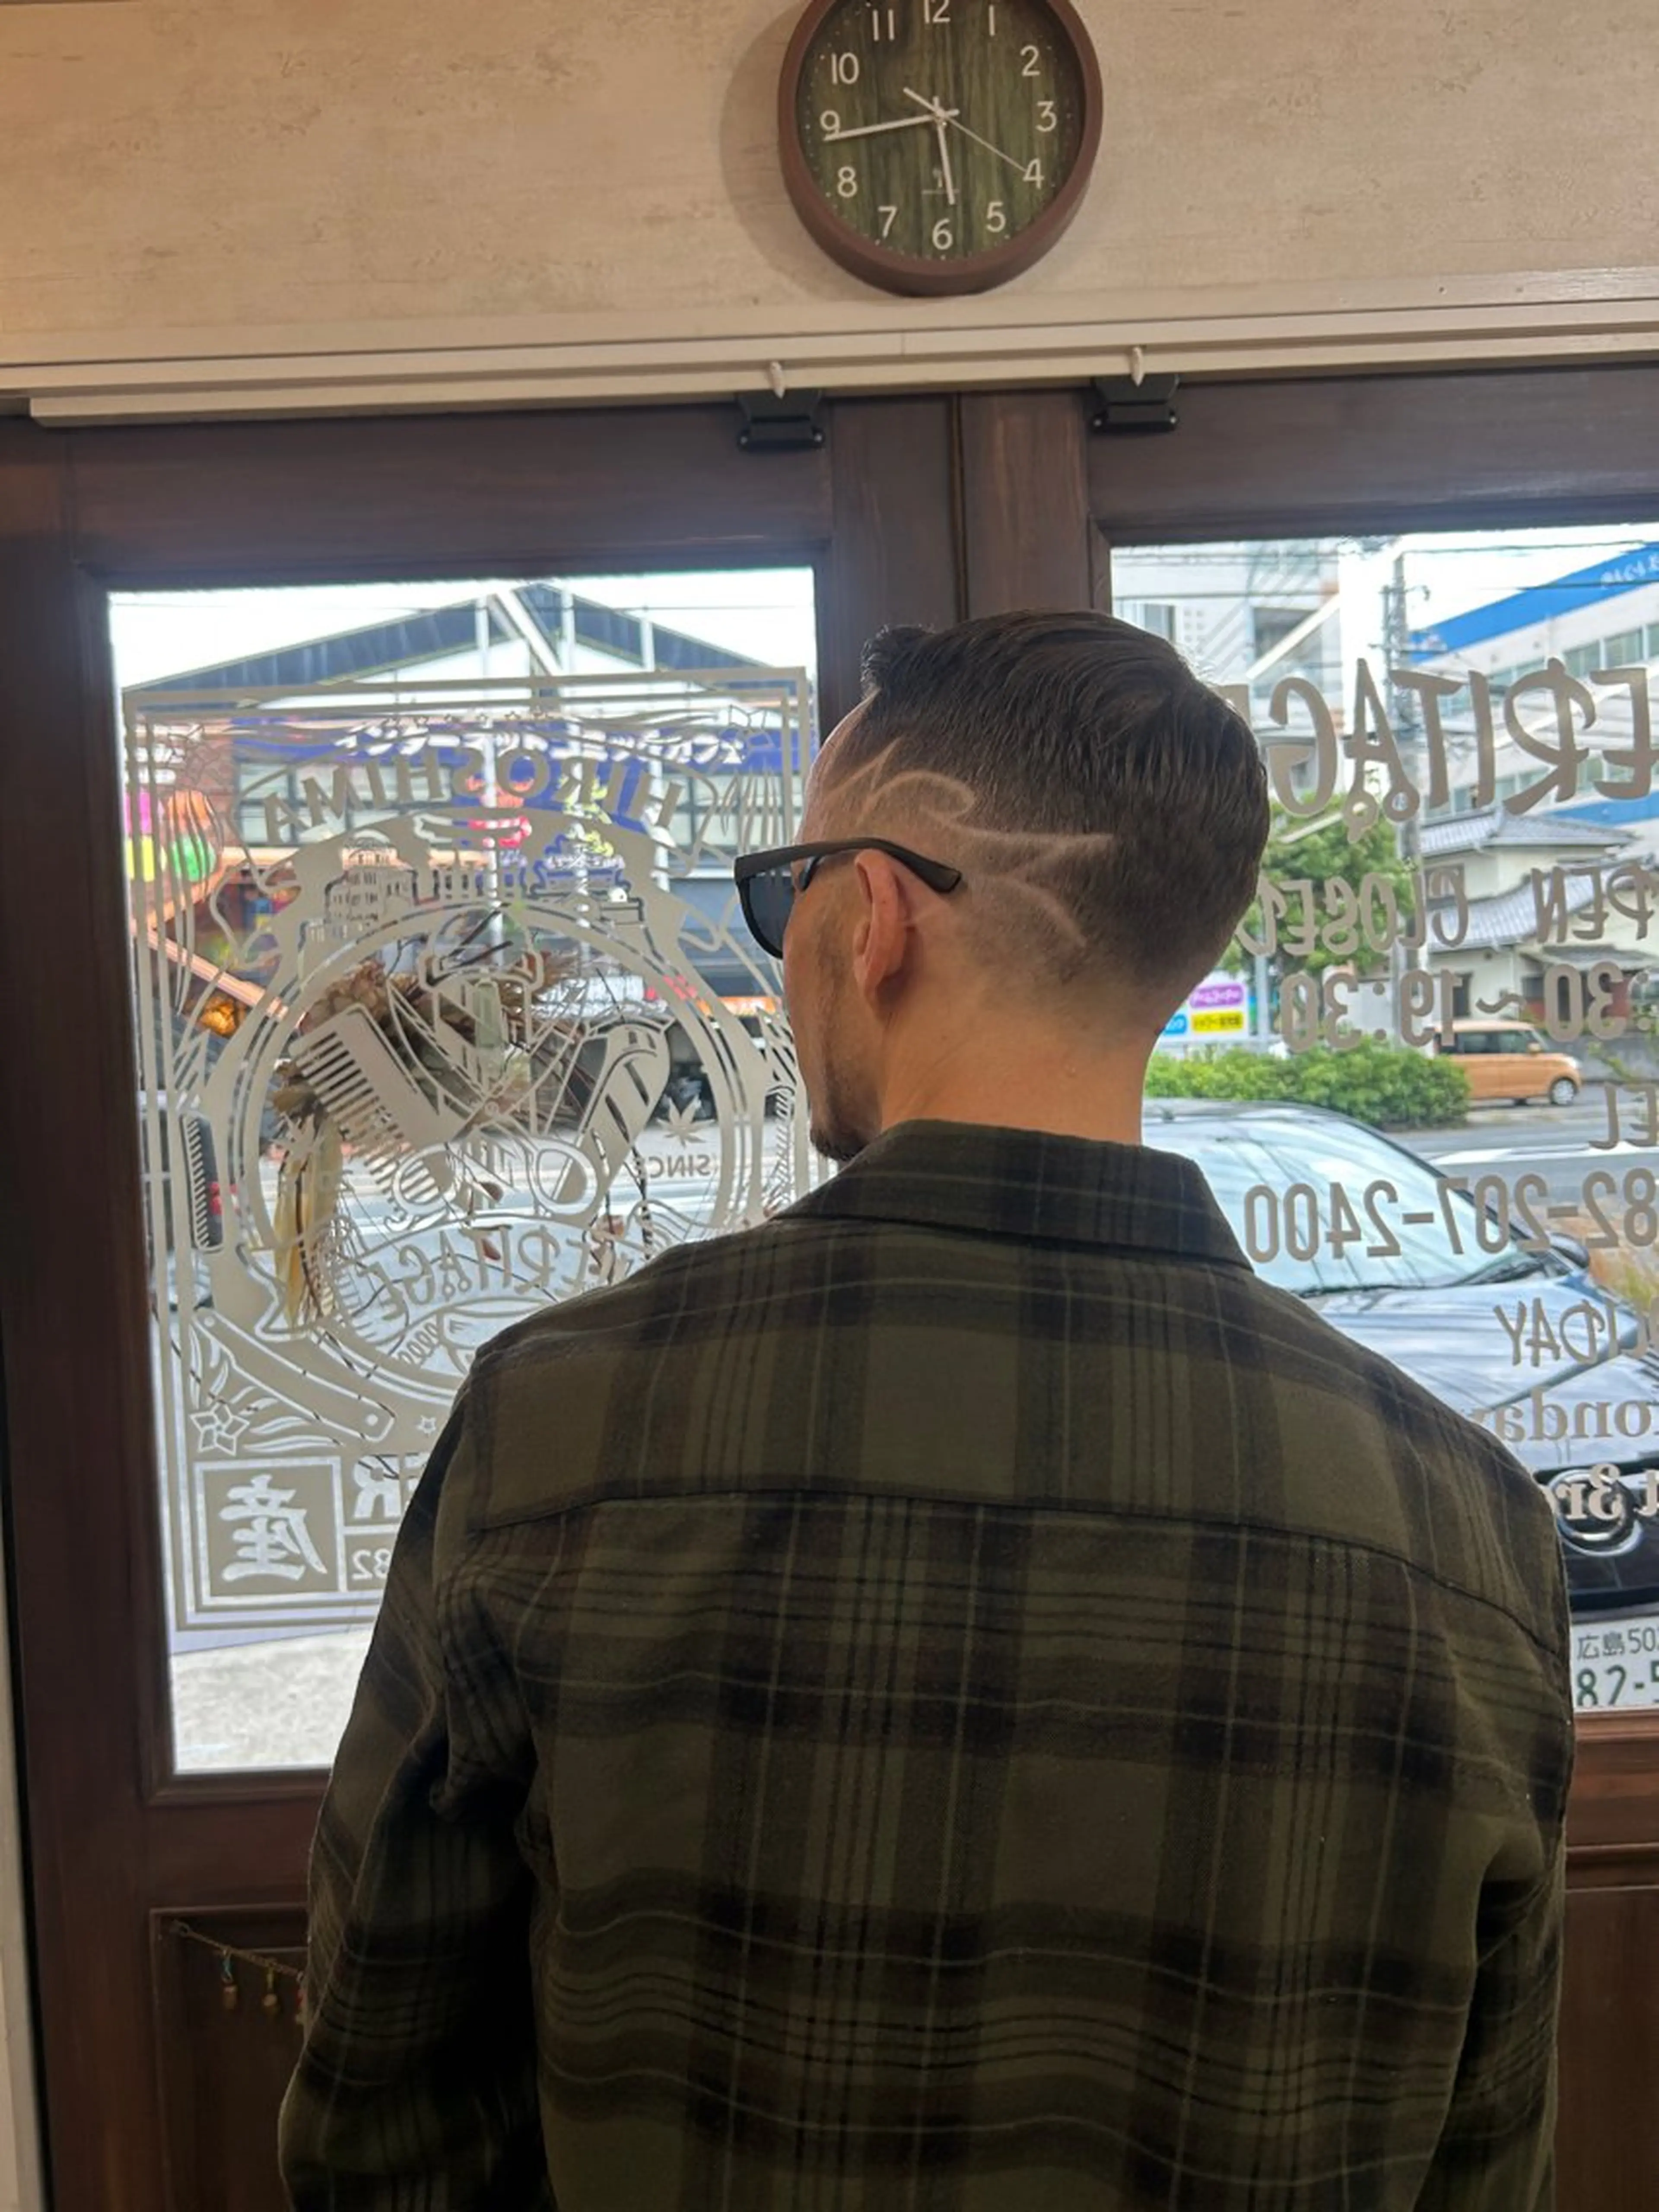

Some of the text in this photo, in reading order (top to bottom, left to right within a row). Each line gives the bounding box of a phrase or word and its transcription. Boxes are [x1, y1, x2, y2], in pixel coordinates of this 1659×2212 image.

[873, 10, 895, 41] 11
[924, 0, 950, 23] 12
[988, 5, 995, 36] 1
[831, 52, 859, 84] 10
[1020, 45, 1040, 76] 2
[820, 110, 841, 136] 9
[1036, 101, 1057, 132] 3
[837, 167, 858, 198] 8
[1023, 159, 1044, 189] 4
[878, 206, 898, 238] 7
[986, 201, 1006, 232] 5
[932, 219, 953, 249] 6
[1628, 1626, 1659, 1654] 50
